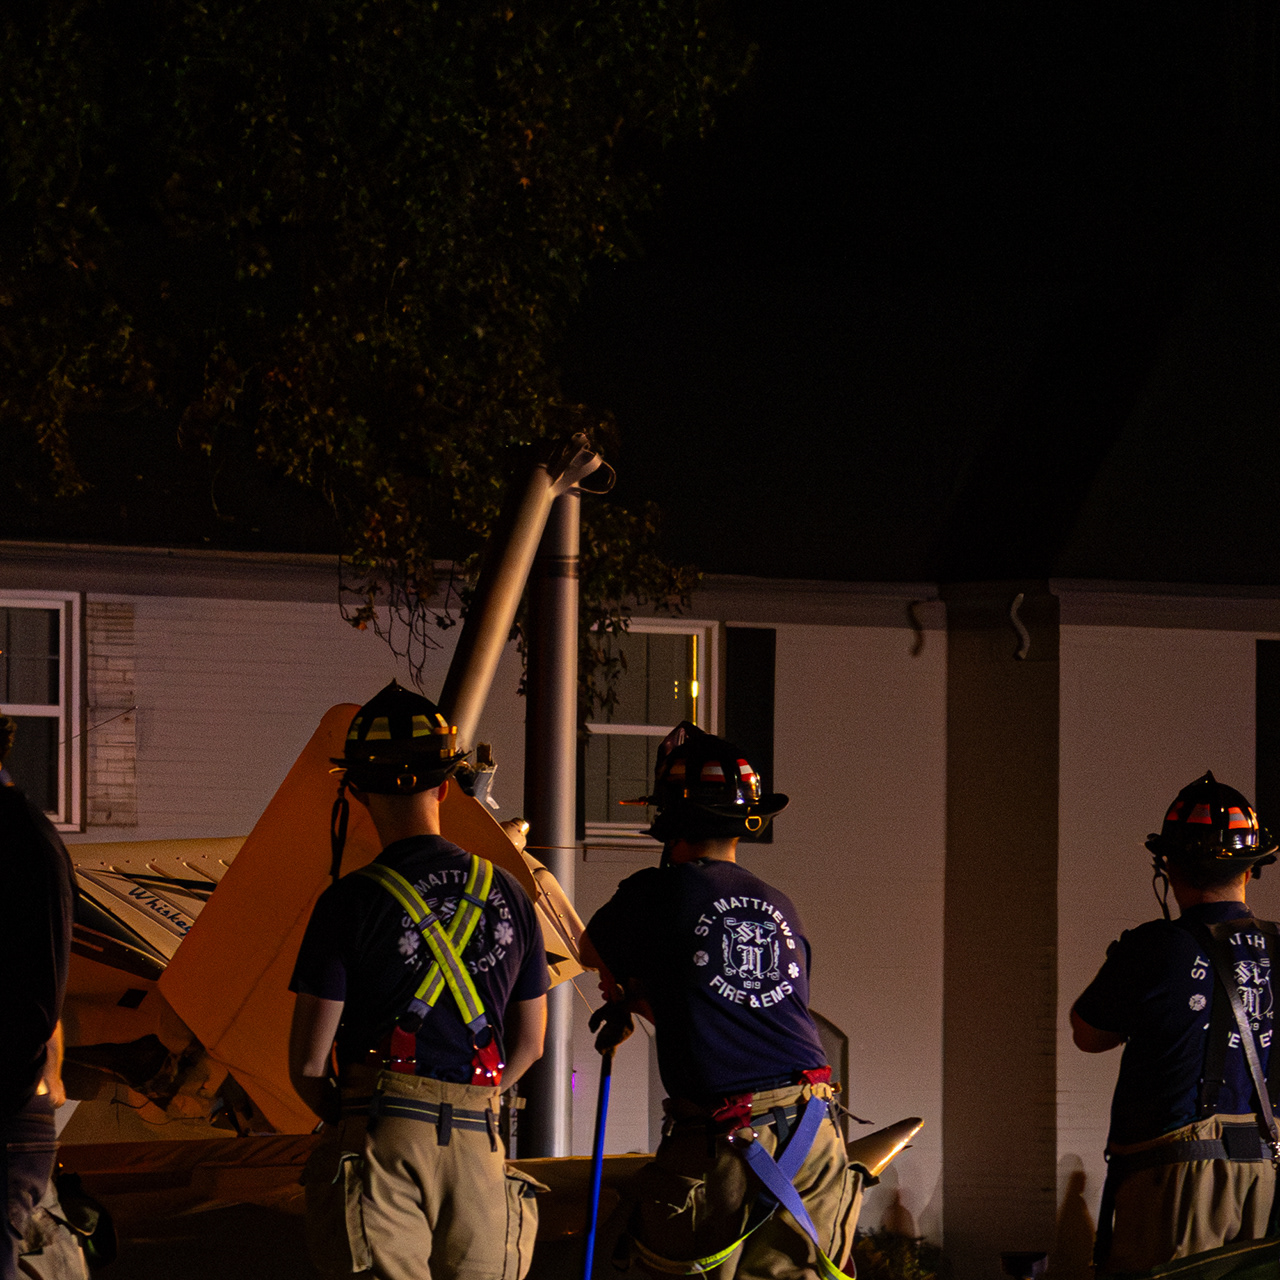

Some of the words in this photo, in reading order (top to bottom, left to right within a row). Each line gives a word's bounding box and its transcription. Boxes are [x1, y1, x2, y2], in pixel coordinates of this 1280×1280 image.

[694, 913, 717, 937] ST.
[713, 896, 796, 950] MATTHEWS
[709, 974, 748, 1006] FIRE
[749, 994, 762, 1009] &
[760, 981, 794, 1008] EMS
[743, 980, 762, 990] 1919
